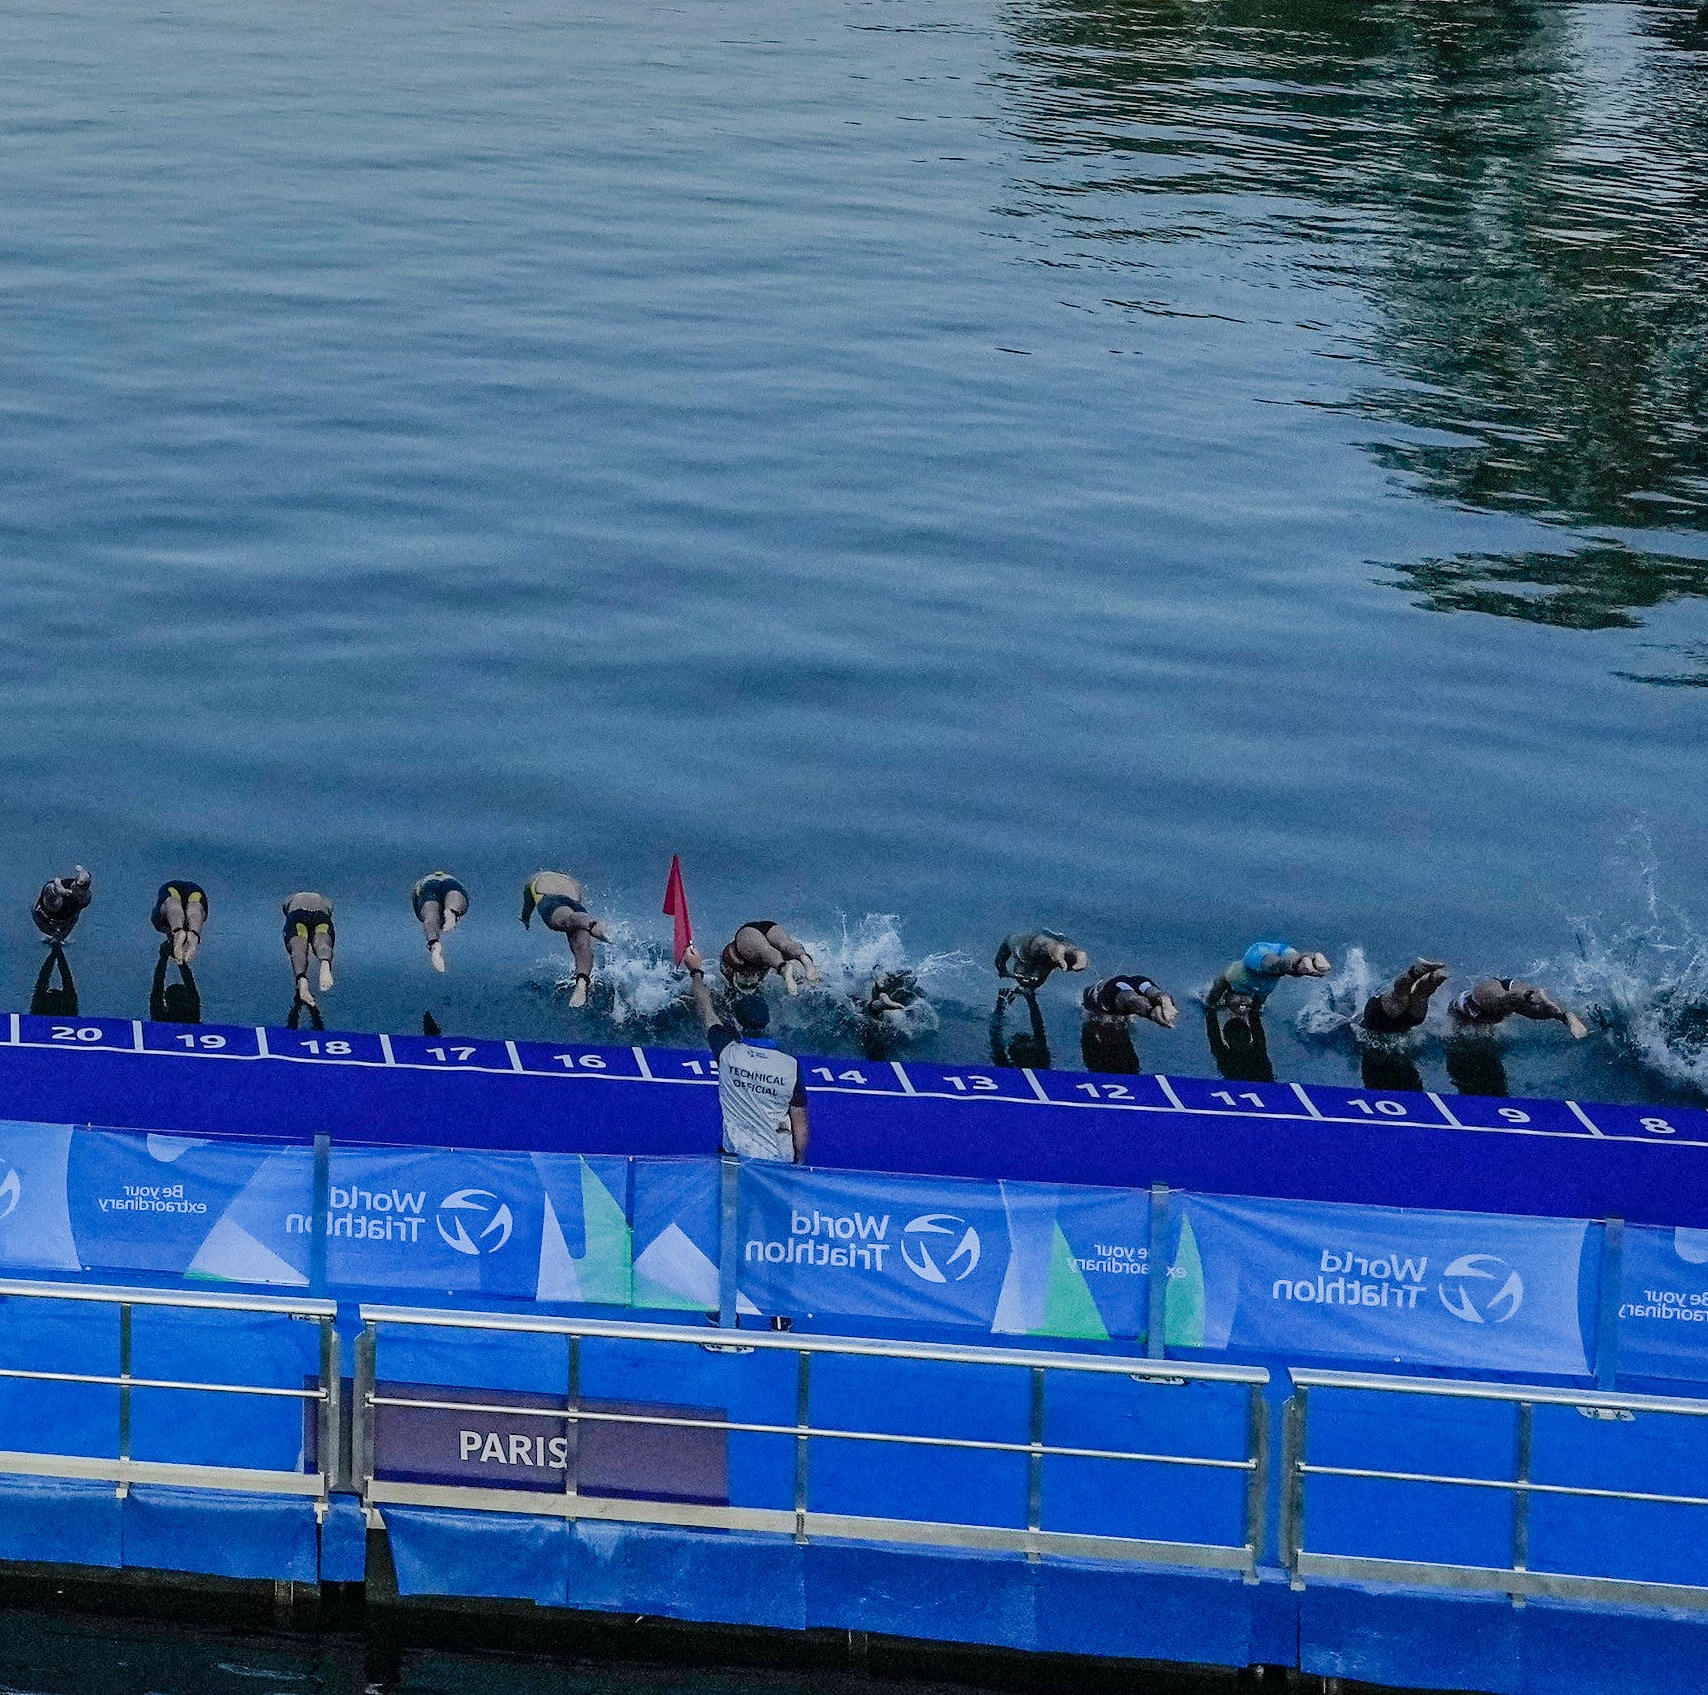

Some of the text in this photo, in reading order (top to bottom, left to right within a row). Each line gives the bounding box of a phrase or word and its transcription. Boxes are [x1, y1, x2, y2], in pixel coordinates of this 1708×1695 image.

[51, 1026, 103, 1041] 20
[175, 1033, 227, 1049] 19
[299, 1040, 352, 1055] 18
[426, 1047, 477, 1062] 17
[553, 1054, 607, 1069] 16
[729, 1066, 785, 1086] TECHNICAL
[811, 1067, 868, 1084] 14
[943, 1075, 999, 1091] 13
[733, 1079, 777, 1096] OFFICIAL
[1076, 1083, 1135, 1100] 12
[1210, 1090, 1266, 1107] 11
[1347, 1098, 1407, 1116] 10
[1497, 1108, 1531, 1123] 9
[1640, 1117, 1676, 1134] 8
[460, 1430, 568, 1469] PARIS
